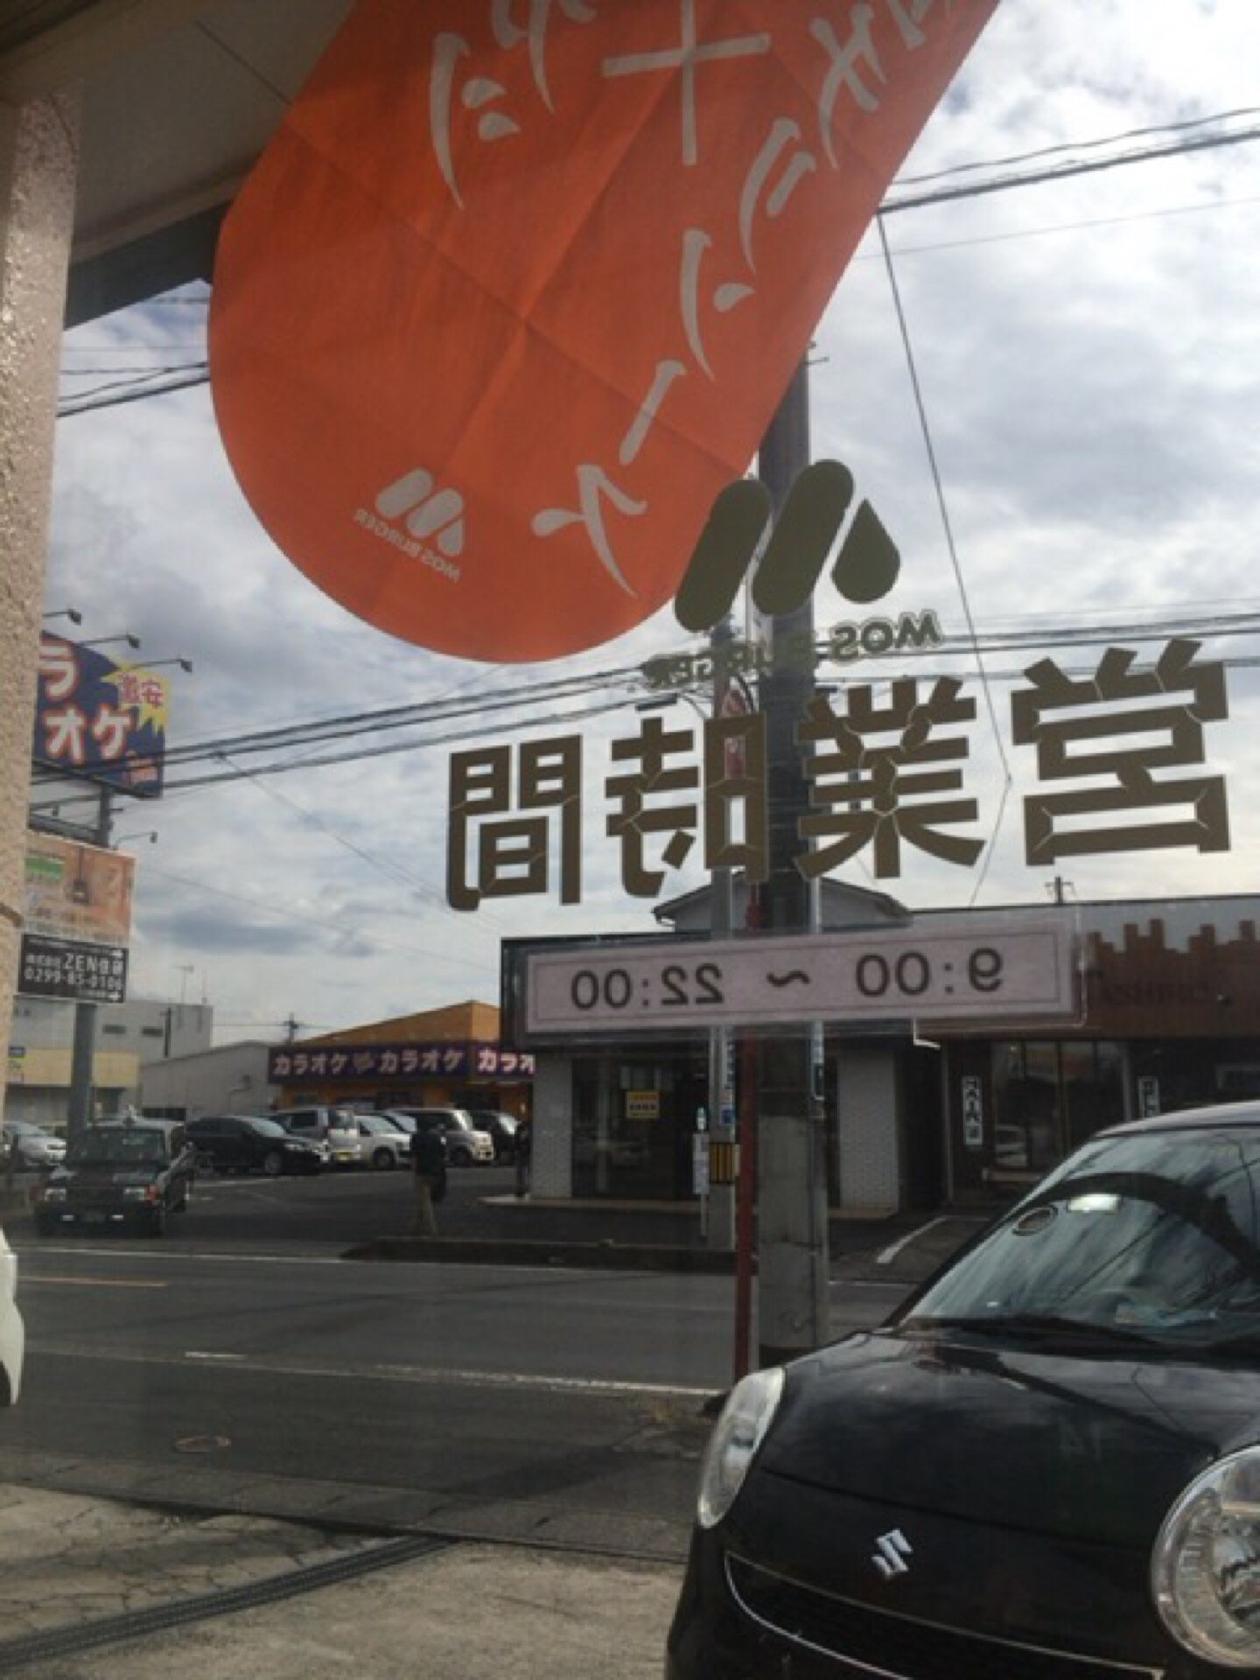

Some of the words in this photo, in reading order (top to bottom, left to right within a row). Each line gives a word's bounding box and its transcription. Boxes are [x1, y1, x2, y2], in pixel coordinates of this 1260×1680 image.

[272, 1053, 348, 1075] カラオケ
[378, 1048, 464, 1073] カラオケ
